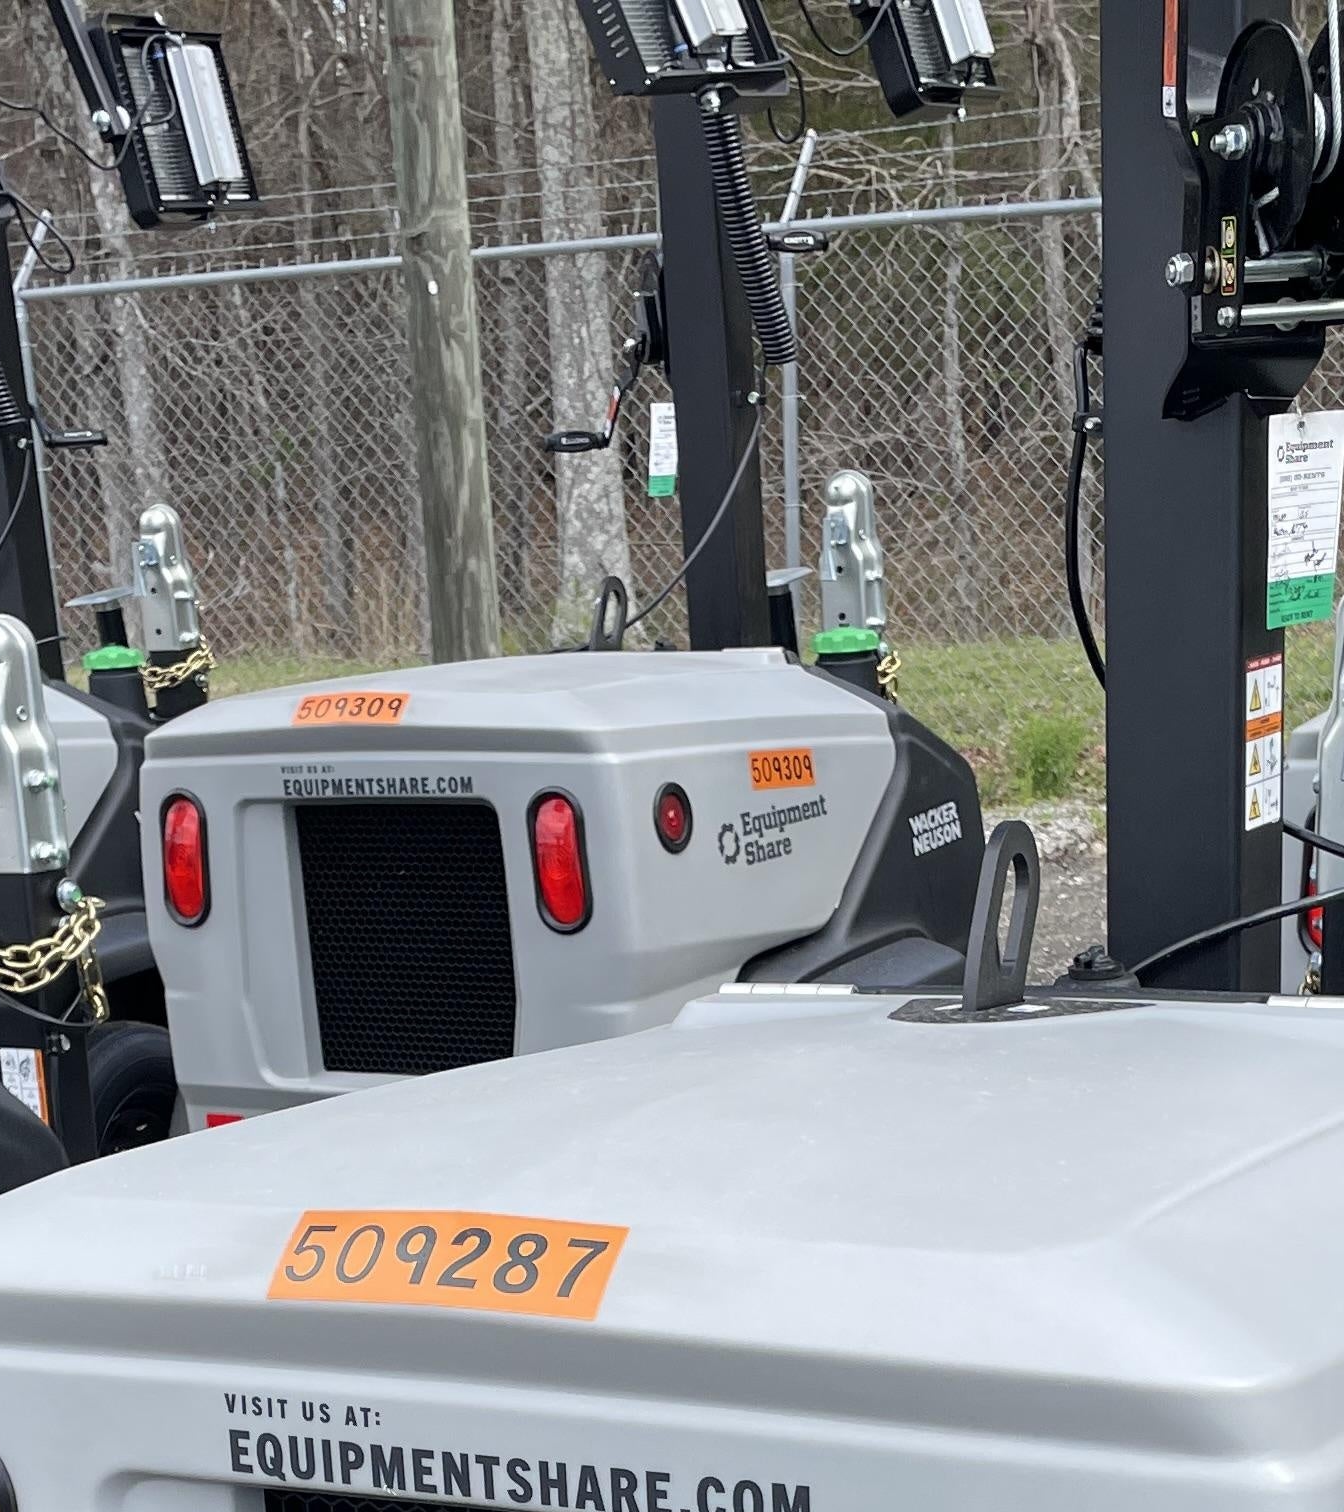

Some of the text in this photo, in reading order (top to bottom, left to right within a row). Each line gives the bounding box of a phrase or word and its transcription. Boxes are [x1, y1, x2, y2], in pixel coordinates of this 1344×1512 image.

[297, 696, 403, 721] 509309
[283, 775, 474, 798] EQUIPMENTSHARE.COM
[751, 754, 814, 784] 509309
[740, 794, 828, 837] Equipment
[909, 800, 959, 838] WACKER
[744, 832, 793, 867] Share
[912, 821, 963, 857] NEUSON
[285, 1224, 610, 1299] 509287
[223, 1392, 383, 1430] VISIT US AT:
